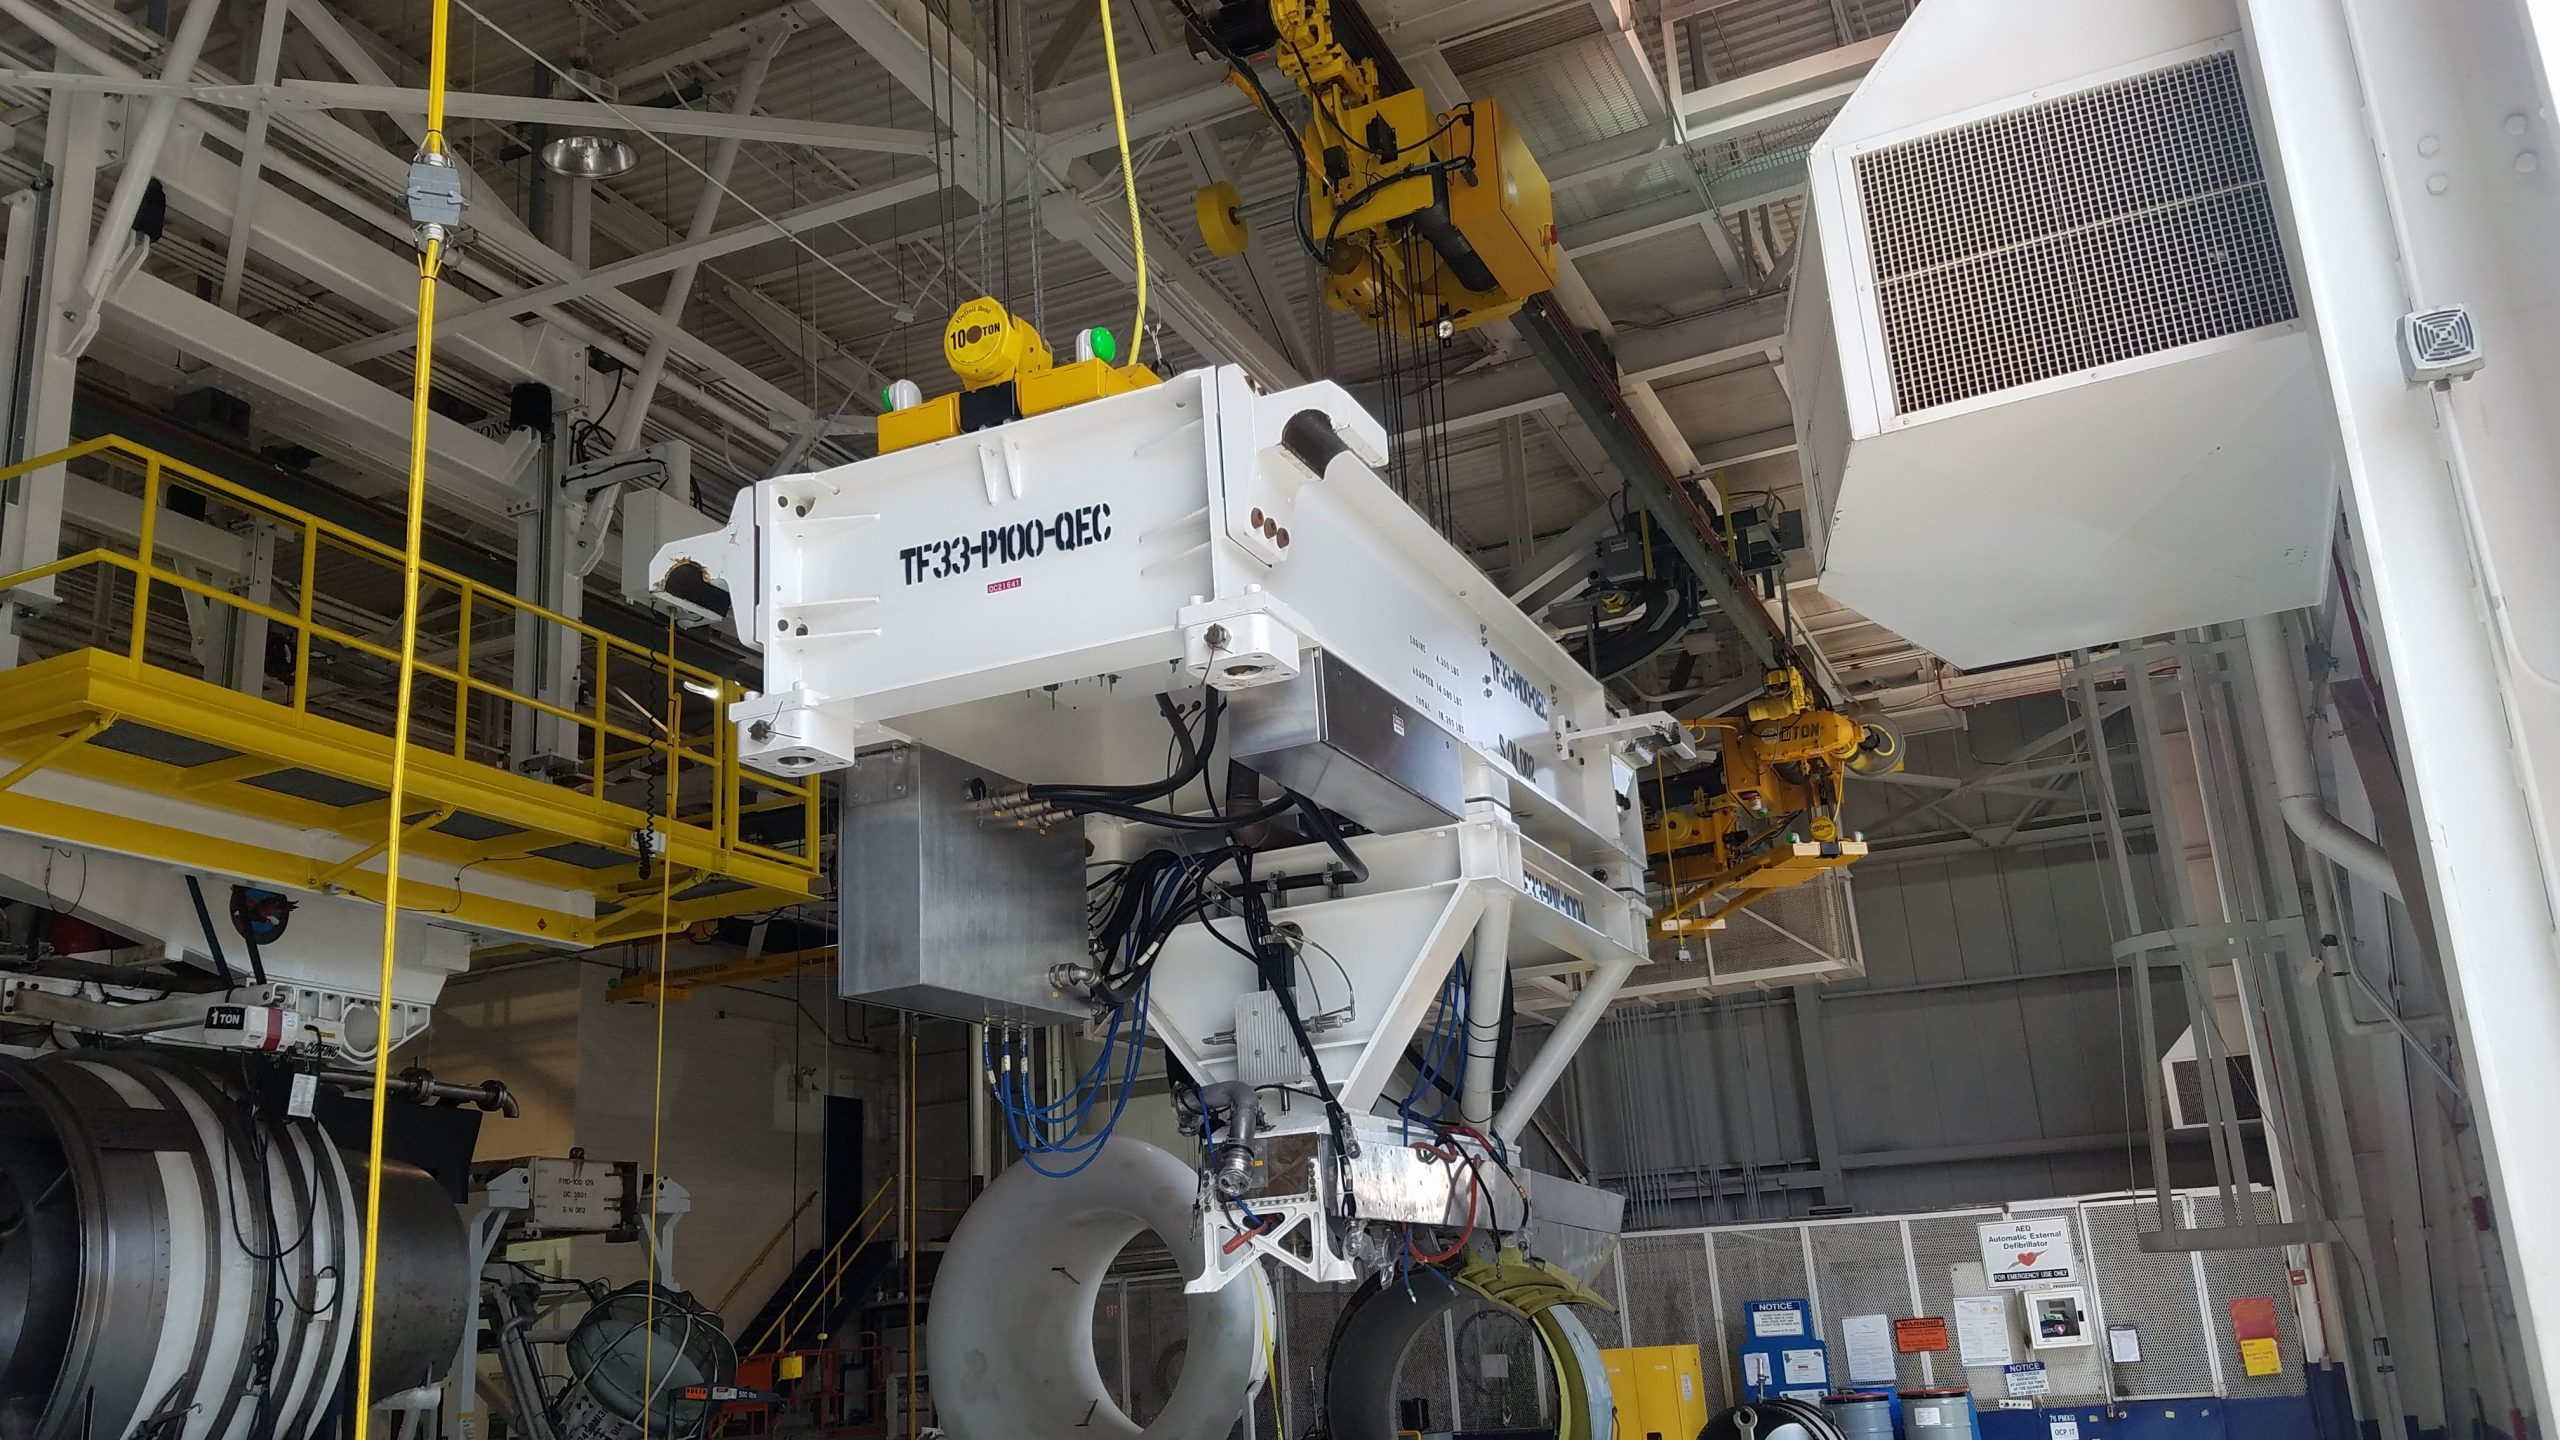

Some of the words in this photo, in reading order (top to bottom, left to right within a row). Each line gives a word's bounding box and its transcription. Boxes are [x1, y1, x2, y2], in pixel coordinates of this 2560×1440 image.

[950, 329, 966, 350] 10
[982, 322, 1001, 336] TON
[899, 502, 1112, 586] TF33-P100-QEC
[1412, 665, 1434, 688] ADAPTER
[1415, 695, 1432, 712] TOTAL
[1793, 722, 1820, 740] TON
[211, 1010, 219, 1025] 1
[220, 1013, 240, 1025] TON
[2015, 1224, 2032, 1233] AED
[1988, 1234, 2027, 1243] Automatic
[2029, 1231, 2062, 1240] External
[2003, 1240, 2048, 1250] Defibrillator
[1994, 1273, 2006, 1281] FOR
[2007, 1272, 2040, 1280] EMERGENCY
[2040, 1270, 2053, 1278] USE
[2053, 1269, 2067, 1277] ONLY
[1759, 1302, 1793, 1311] NOTICE
[1900, 1320, 1940, 1328] WARNING
[2009, 1363, 2041, 1372] NOTICE
[2054, 1428, 2067, 1436] OCP
